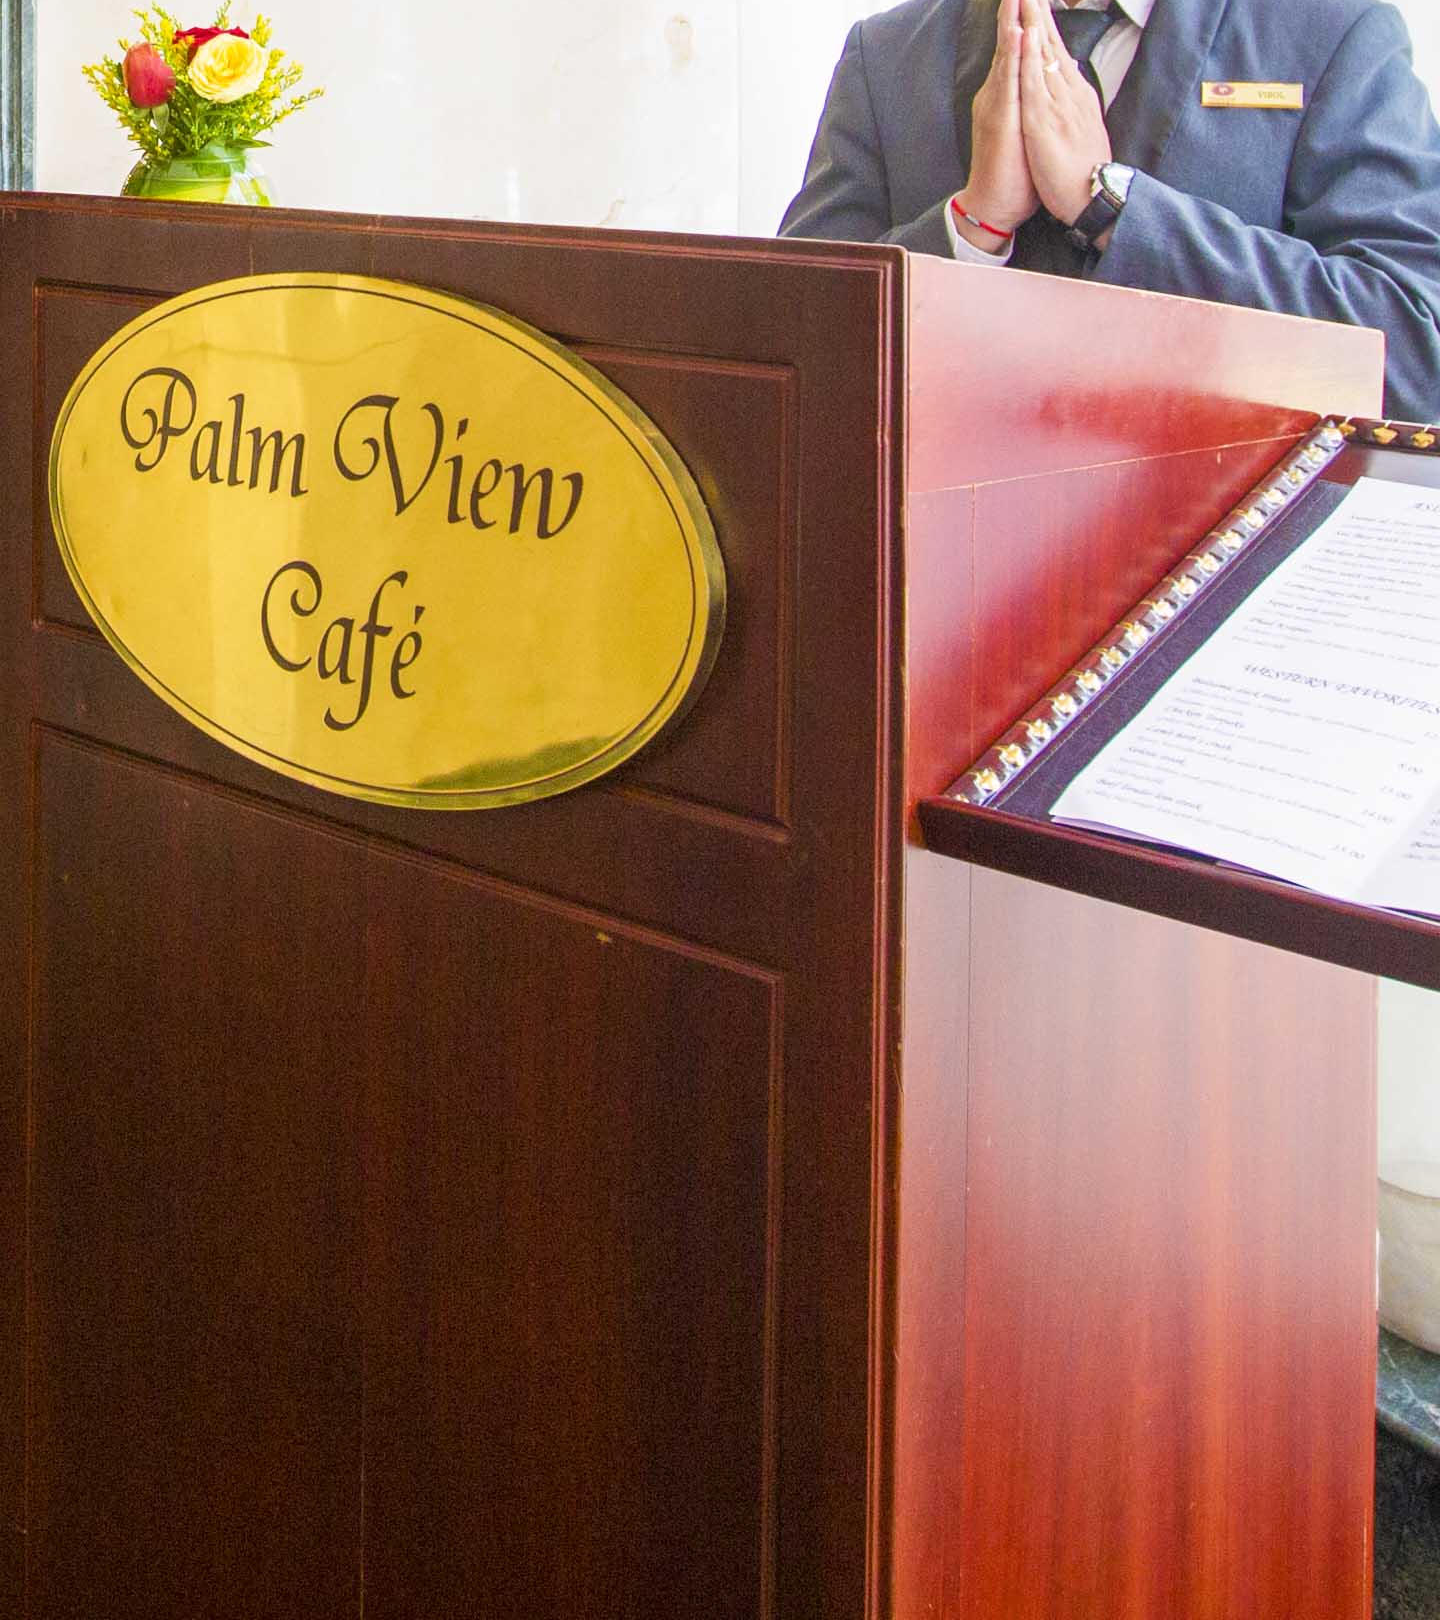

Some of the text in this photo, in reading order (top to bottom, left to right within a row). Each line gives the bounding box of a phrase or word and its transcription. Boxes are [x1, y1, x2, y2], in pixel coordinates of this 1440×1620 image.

[120, 366, 584, 541] Palm View
[260, 559, 428, 731] Café
[1243, 664, 1328, 689] WESTERN
